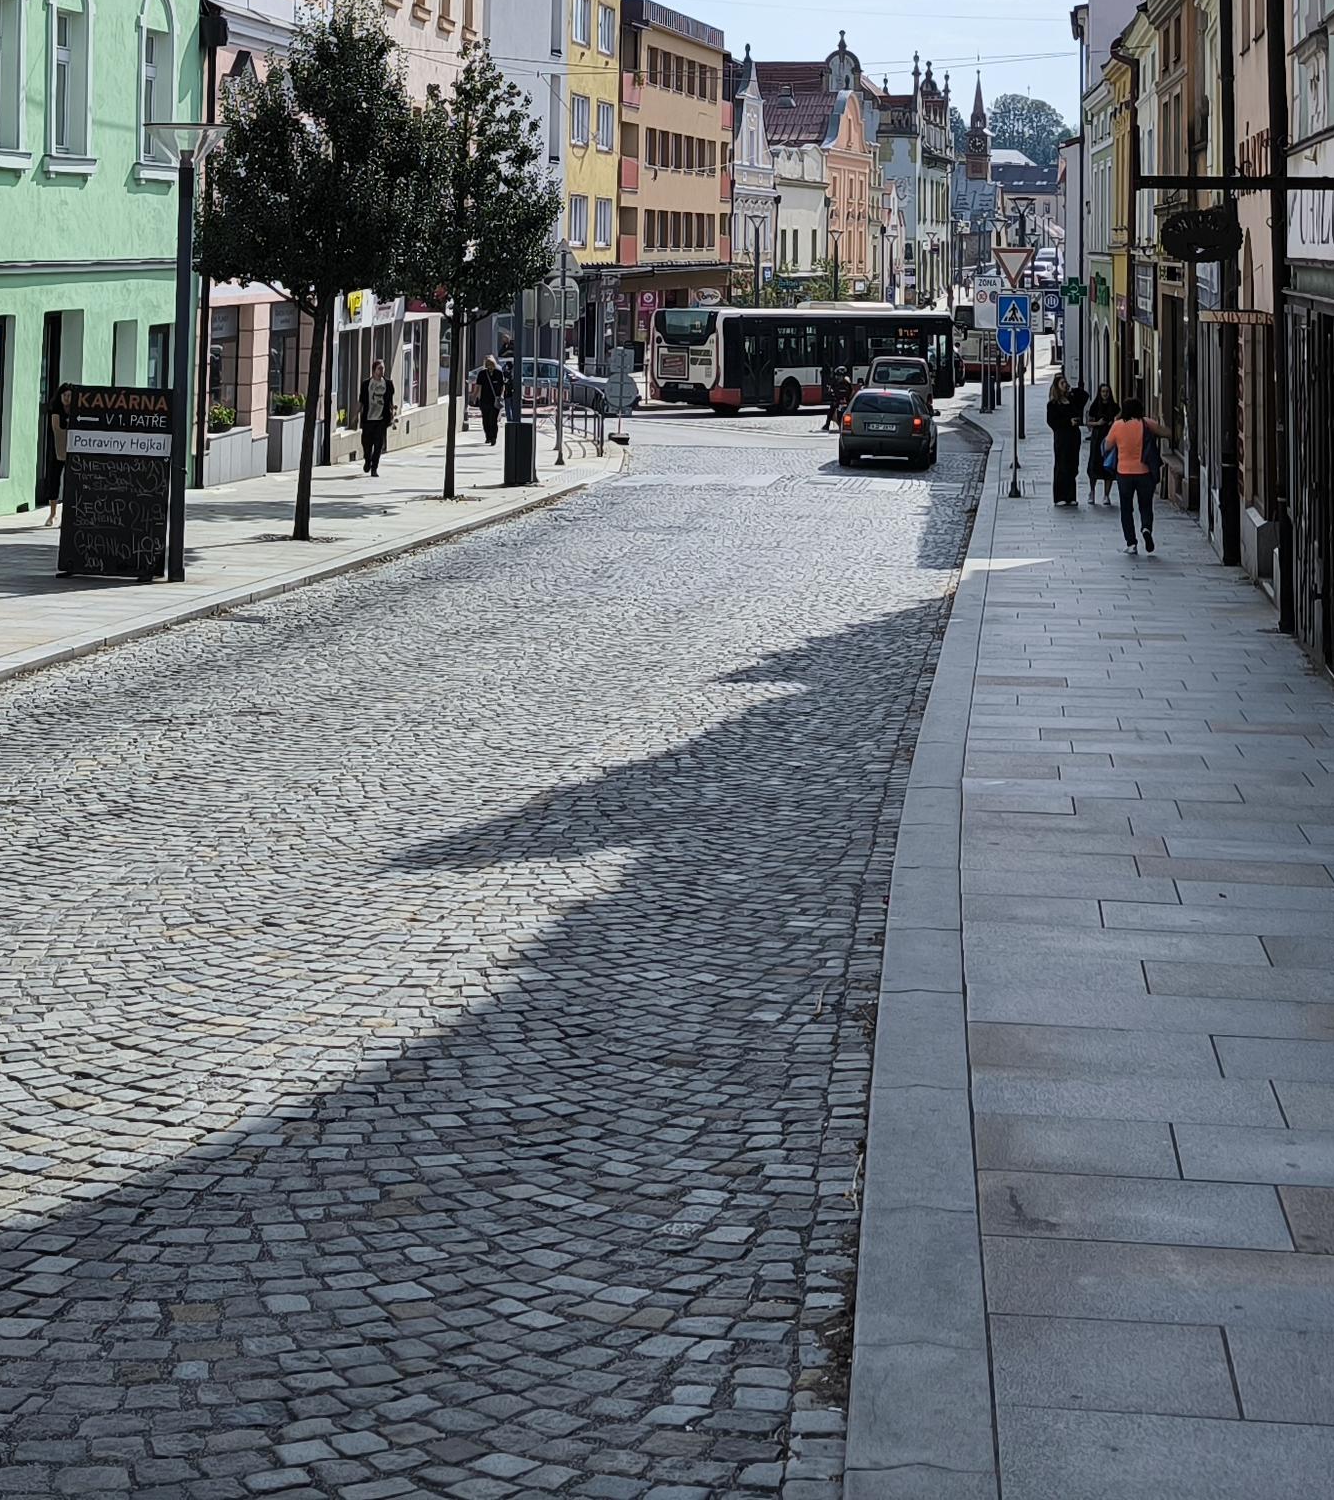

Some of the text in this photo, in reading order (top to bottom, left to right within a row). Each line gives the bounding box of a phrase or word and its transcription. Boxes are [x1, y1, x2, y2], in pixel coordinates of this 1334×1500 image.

[77, 389, 168, 412] KAVÁRNA
[105, 412, 167, 428] V 1. PATŘE
[73, 435, 167, 453] Potraviny Hejkal
